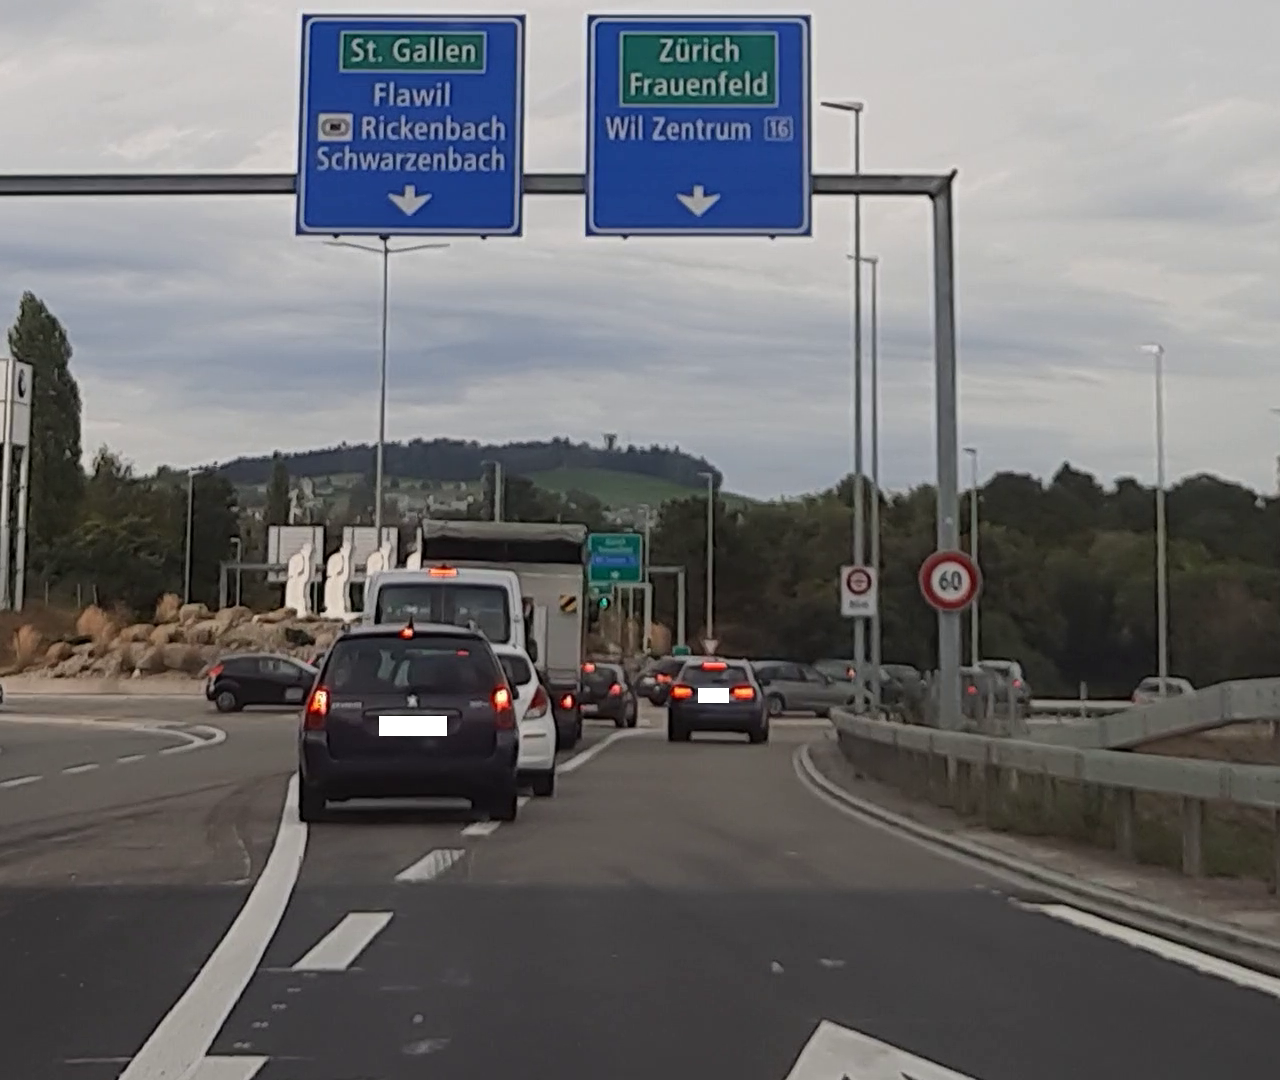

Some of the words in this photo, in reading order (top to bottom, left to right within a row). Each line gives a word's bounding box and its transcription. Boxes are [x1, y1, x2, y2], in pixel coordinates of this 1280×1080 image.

[350, 37, 384, 63] St.
[392, 36, 476, 63] Gallen
[658, 36, 740, 63] Zürich
[373, 81, 451, 107] Flawil
[629, 71, 768, 97] Frauenfeld
[361, 115, 506, 141] Rickenbach
[605, 115, 643, 141] Wil
[651, 116, 752, 141] Zentrum
[769, 120, 789, 138] 16
[316, 146, 505, 172] Schwarzenbach
[938, 570, 962, 591] 60
